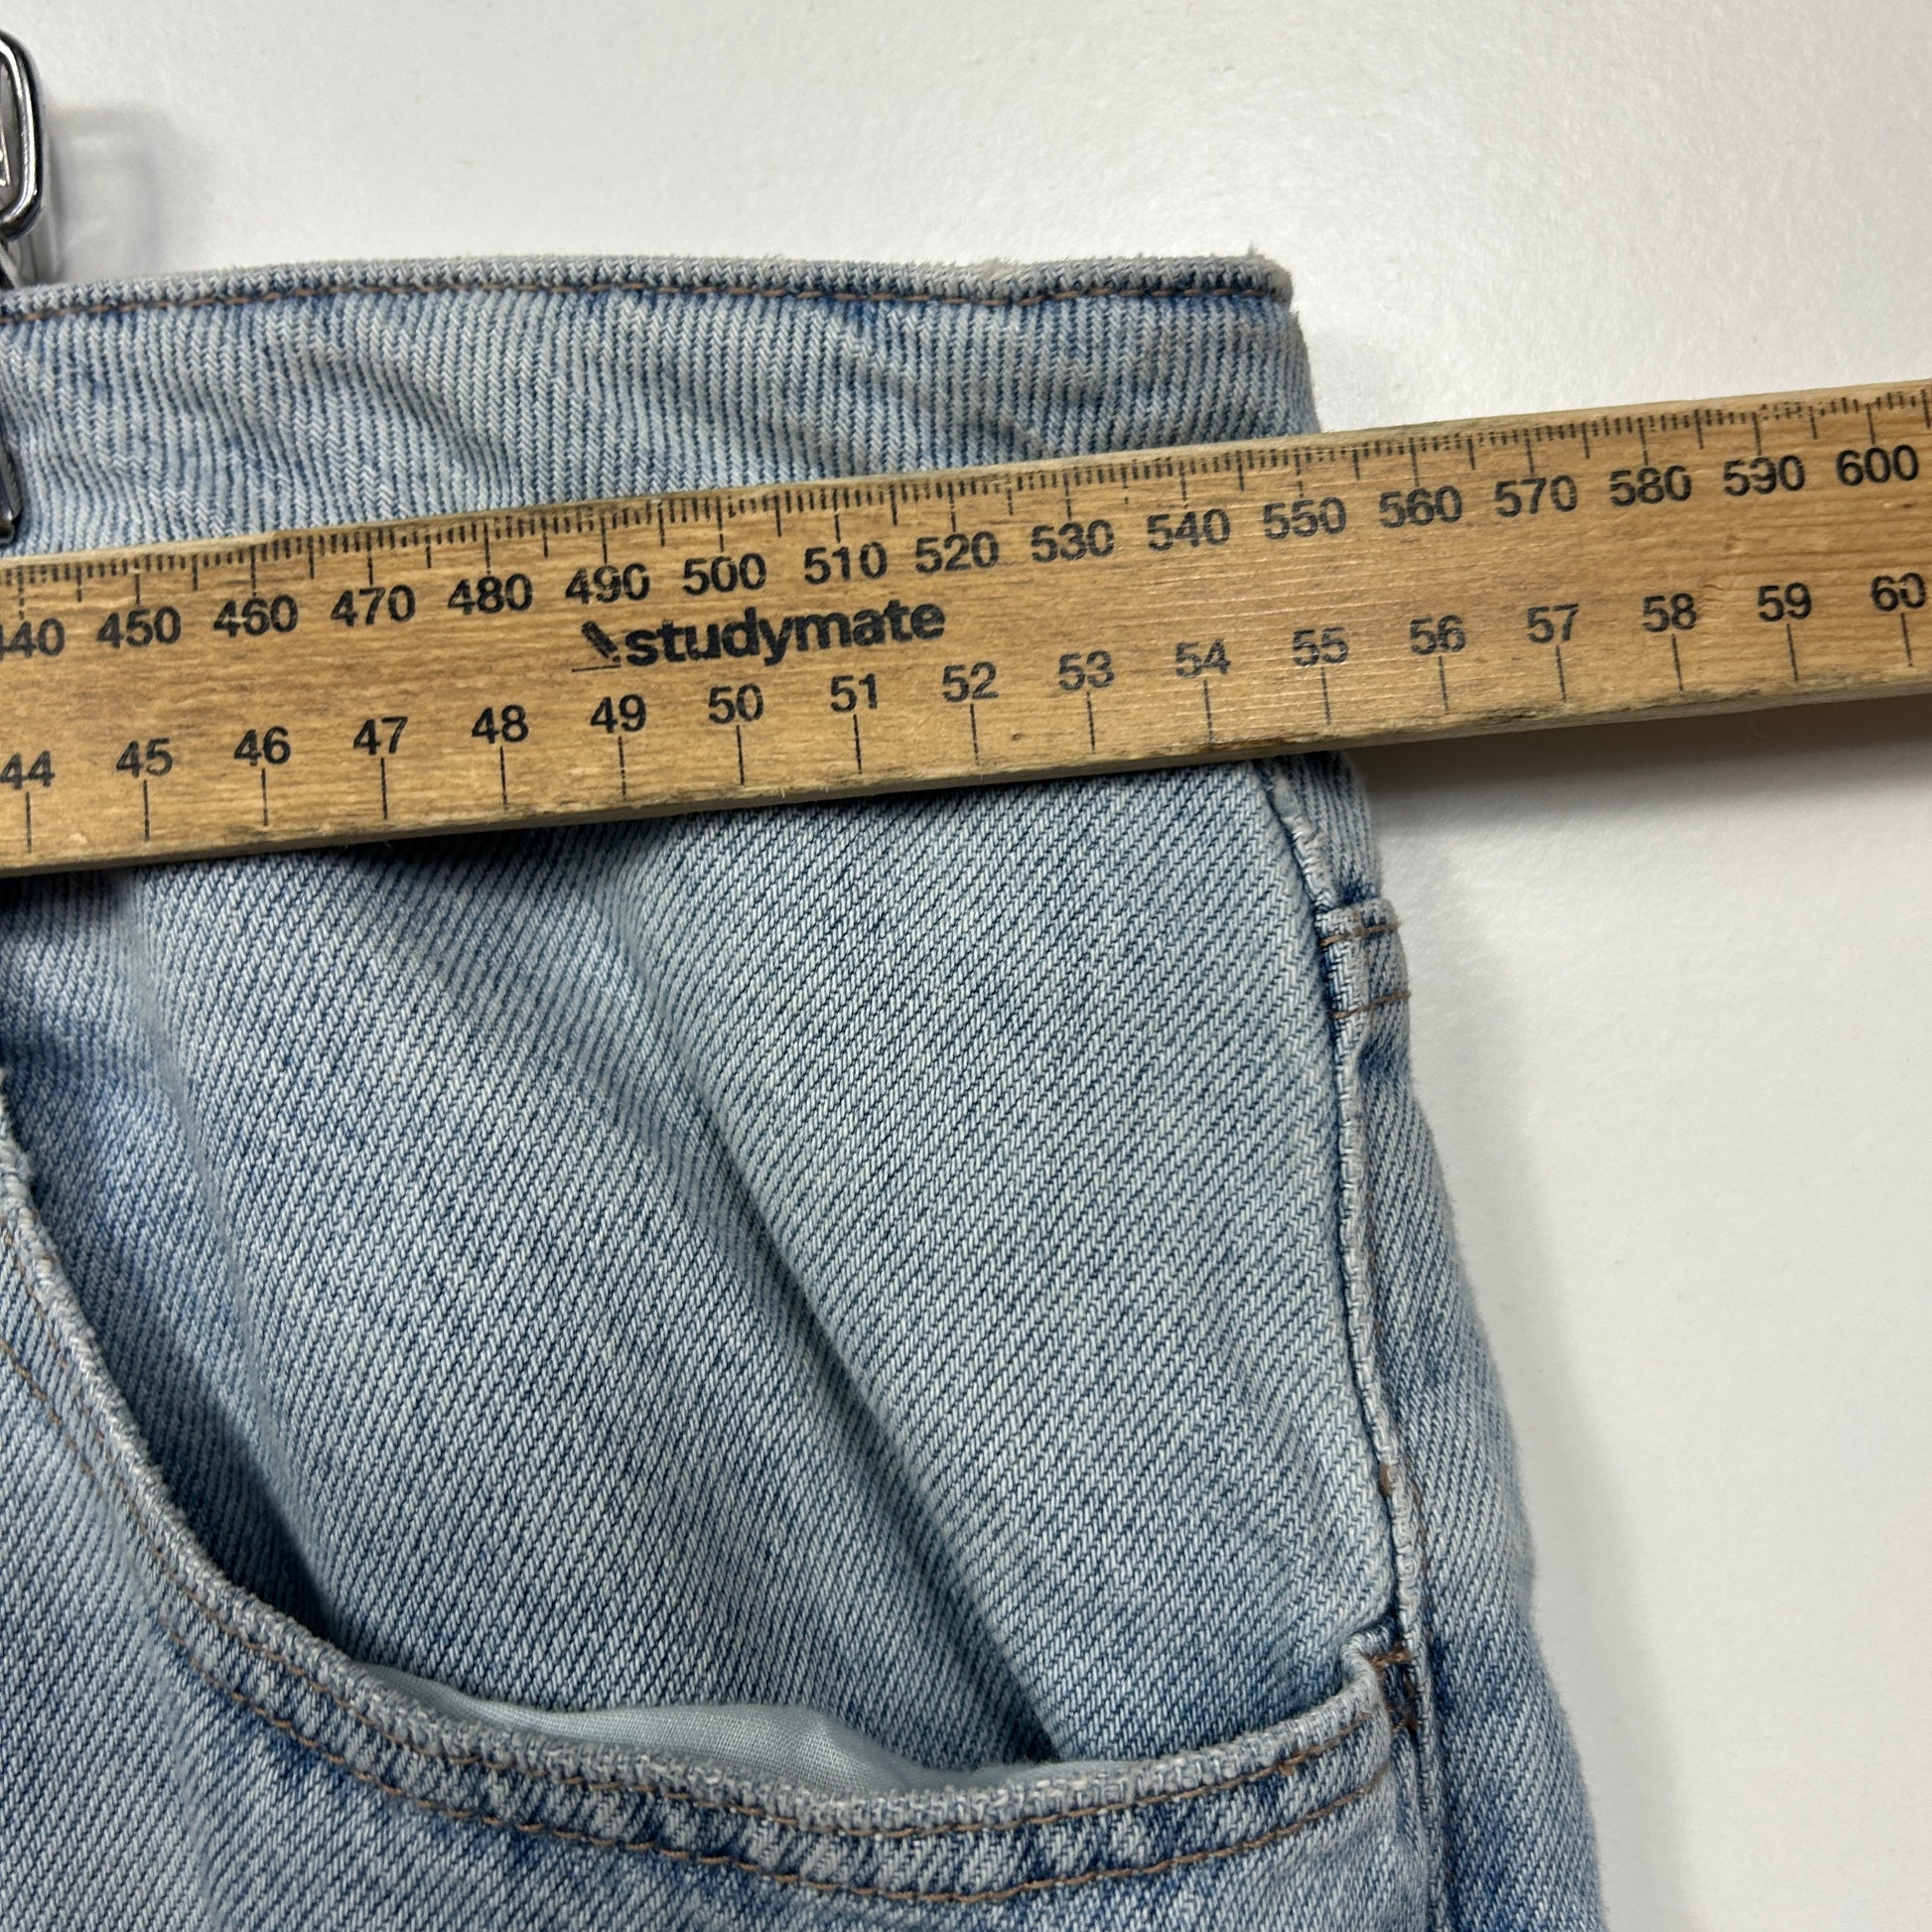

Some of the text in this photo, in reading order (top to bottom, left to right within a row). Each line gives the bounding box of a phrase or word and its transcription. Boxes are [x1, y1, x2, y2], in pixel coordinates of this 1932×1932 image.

[0, 444, 1920, 661] 40 450 460 470 480 490 500 510 520 530 540 550 560 570 580 590 600
[624, 599, 946, 667] studymate
[0, 572, 1927, 790] 44 45 46 47 48 49 50 51 52 53 54 55 56 57 58 59 60
